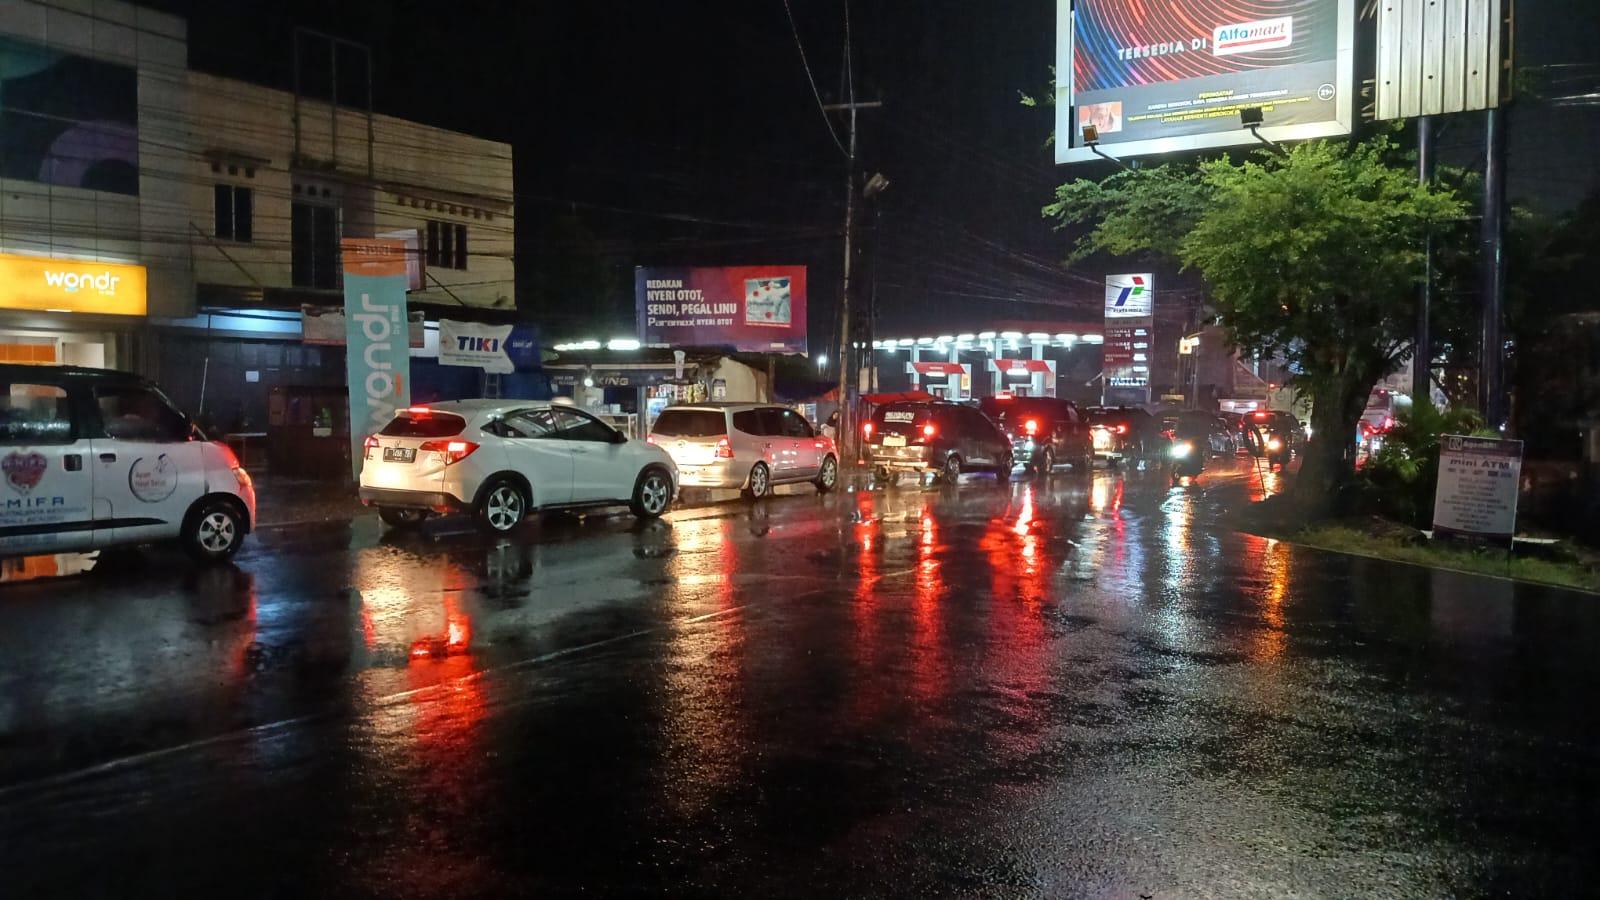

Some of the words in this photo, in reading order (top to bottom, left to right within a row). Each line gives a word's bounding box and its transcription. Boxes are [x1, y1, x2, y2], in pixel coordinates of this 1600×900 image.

[1218, 22, 1286, 42] Alfamart
[1118, 40, 1185, 61] TERSEDIA
[1191, 38, 1207, 51] DI
[44, 270, 120, 292] wondr
[646, 280, 683, 289] REDAKAN
[647, 291, 675, 302] NYERI
[677, 289, 705, 302] OTOT,
[648, 304, 679, 316] SENDI,
[681, 303, 712, 315] PEGAL
[714, 303, 737, 314] LINU
[716, 318, 733, 326] OTOT
[457, 336, 499, 352] TIKI
[353, 293, 395, 433] wondr
[1450, 459, 1477, 467] mini
[1482, 460, 1510, 469] ATM
